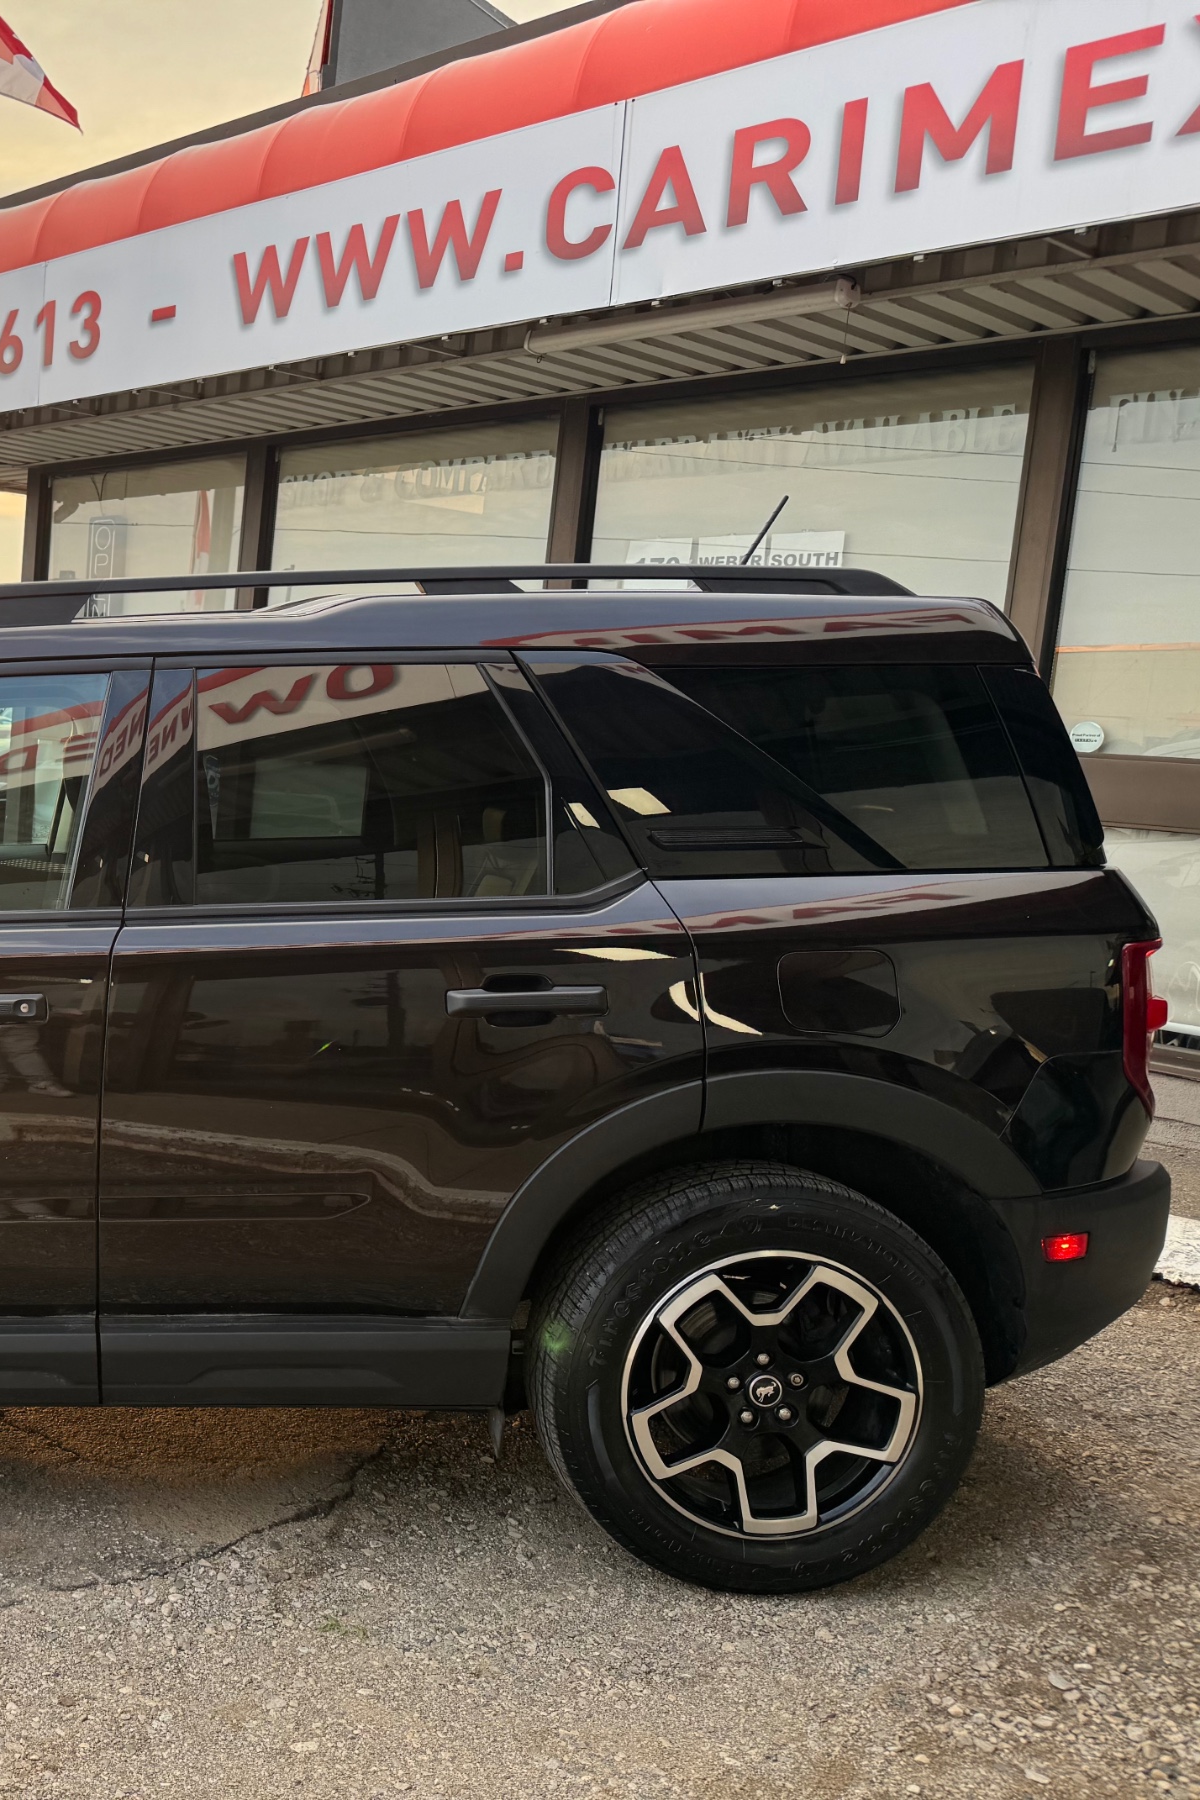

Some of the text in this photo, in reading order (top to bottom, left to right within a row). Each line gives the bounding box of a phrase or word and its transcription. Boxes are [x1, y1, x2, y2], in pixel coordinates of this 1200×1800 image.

[232, 14, 1200, 326] WWW.CARIME
[803, 403, 1017, 466] AVAILABLE
[770, 552, 839, 567] SOUTH
